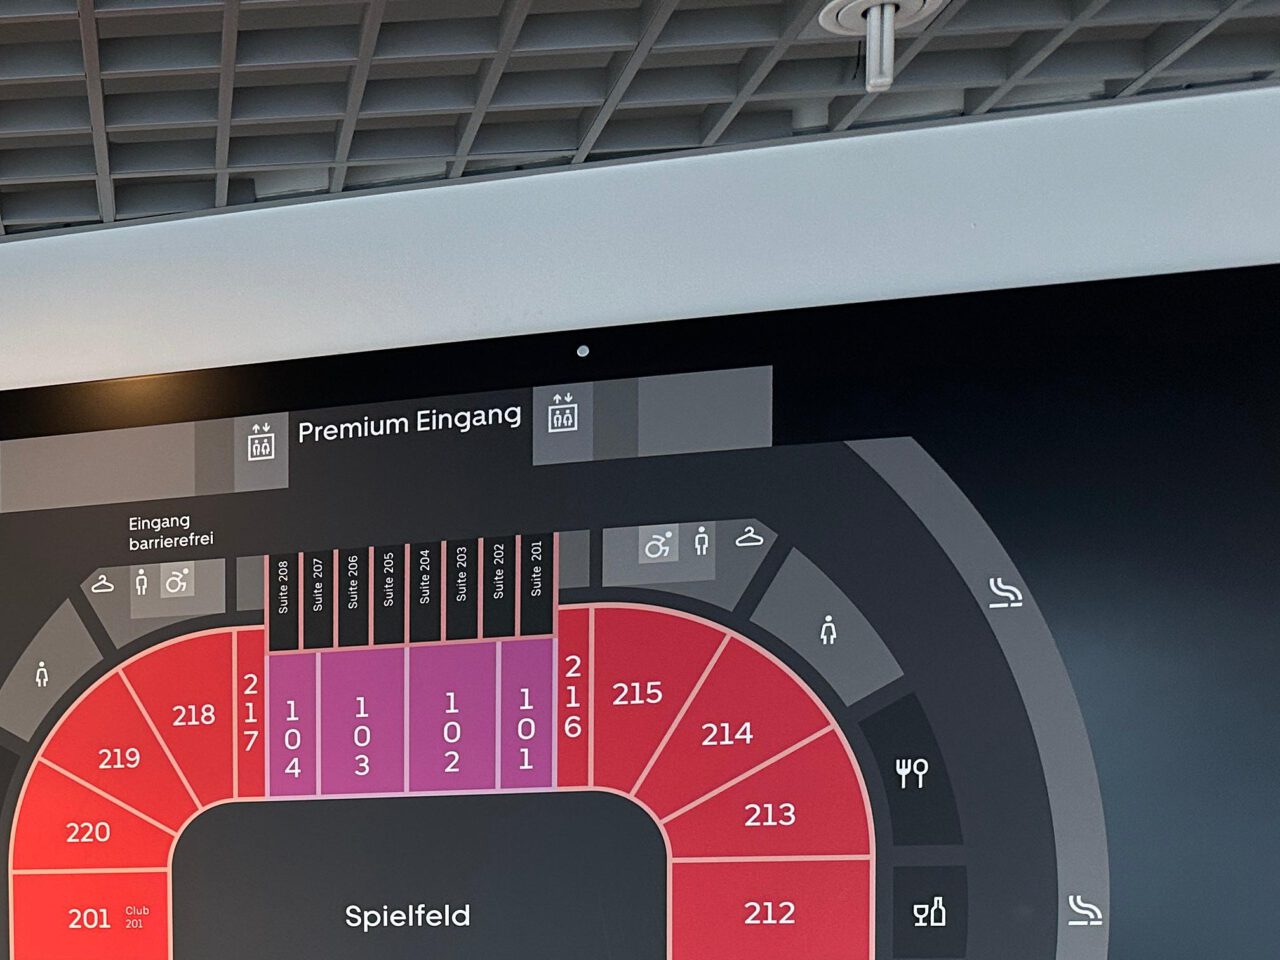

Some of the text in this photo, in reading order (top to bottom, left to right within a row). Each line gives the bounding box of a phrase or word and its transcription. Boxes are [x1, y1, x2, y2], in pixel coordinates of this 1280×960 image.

[299, 406, 521, 443] Premium Eingang
[129, 515, 190, 532] Eingang
[129, 531, 214, 551] barrierefrei
[347, 555, 358, 609] Suite 206
[383, 552, 394, 607] Suite 205
[419, 549, 430, 604] Suite 204
[456, 546, 467, 602] Suite 203
[493, 543, 504, 599] Suite 202
[530, 540, 542, 597] Suite 201
[278, 560, 288, 614] Suite 208
[312, 558, 323, 612] Suite 207
[612, 681, 663, 705] 215
[172, 703, 216, 726] 218
[243, 673, 259, 752] 217
[284, 700, 302, 778] 104
[701, 721, 754, 746] 214
[98, 747, 141, 769] 219
[744, 802, 796, 827] 213
[66, 821, 111, 843] 220
[68, 908, 111, 929] 201
[125, 906, 150, 916] Club
[125, 918, 143, 929] 201
[345, 903, 470, 933] Spielfeld
[744, 901, 795, 924] 212
